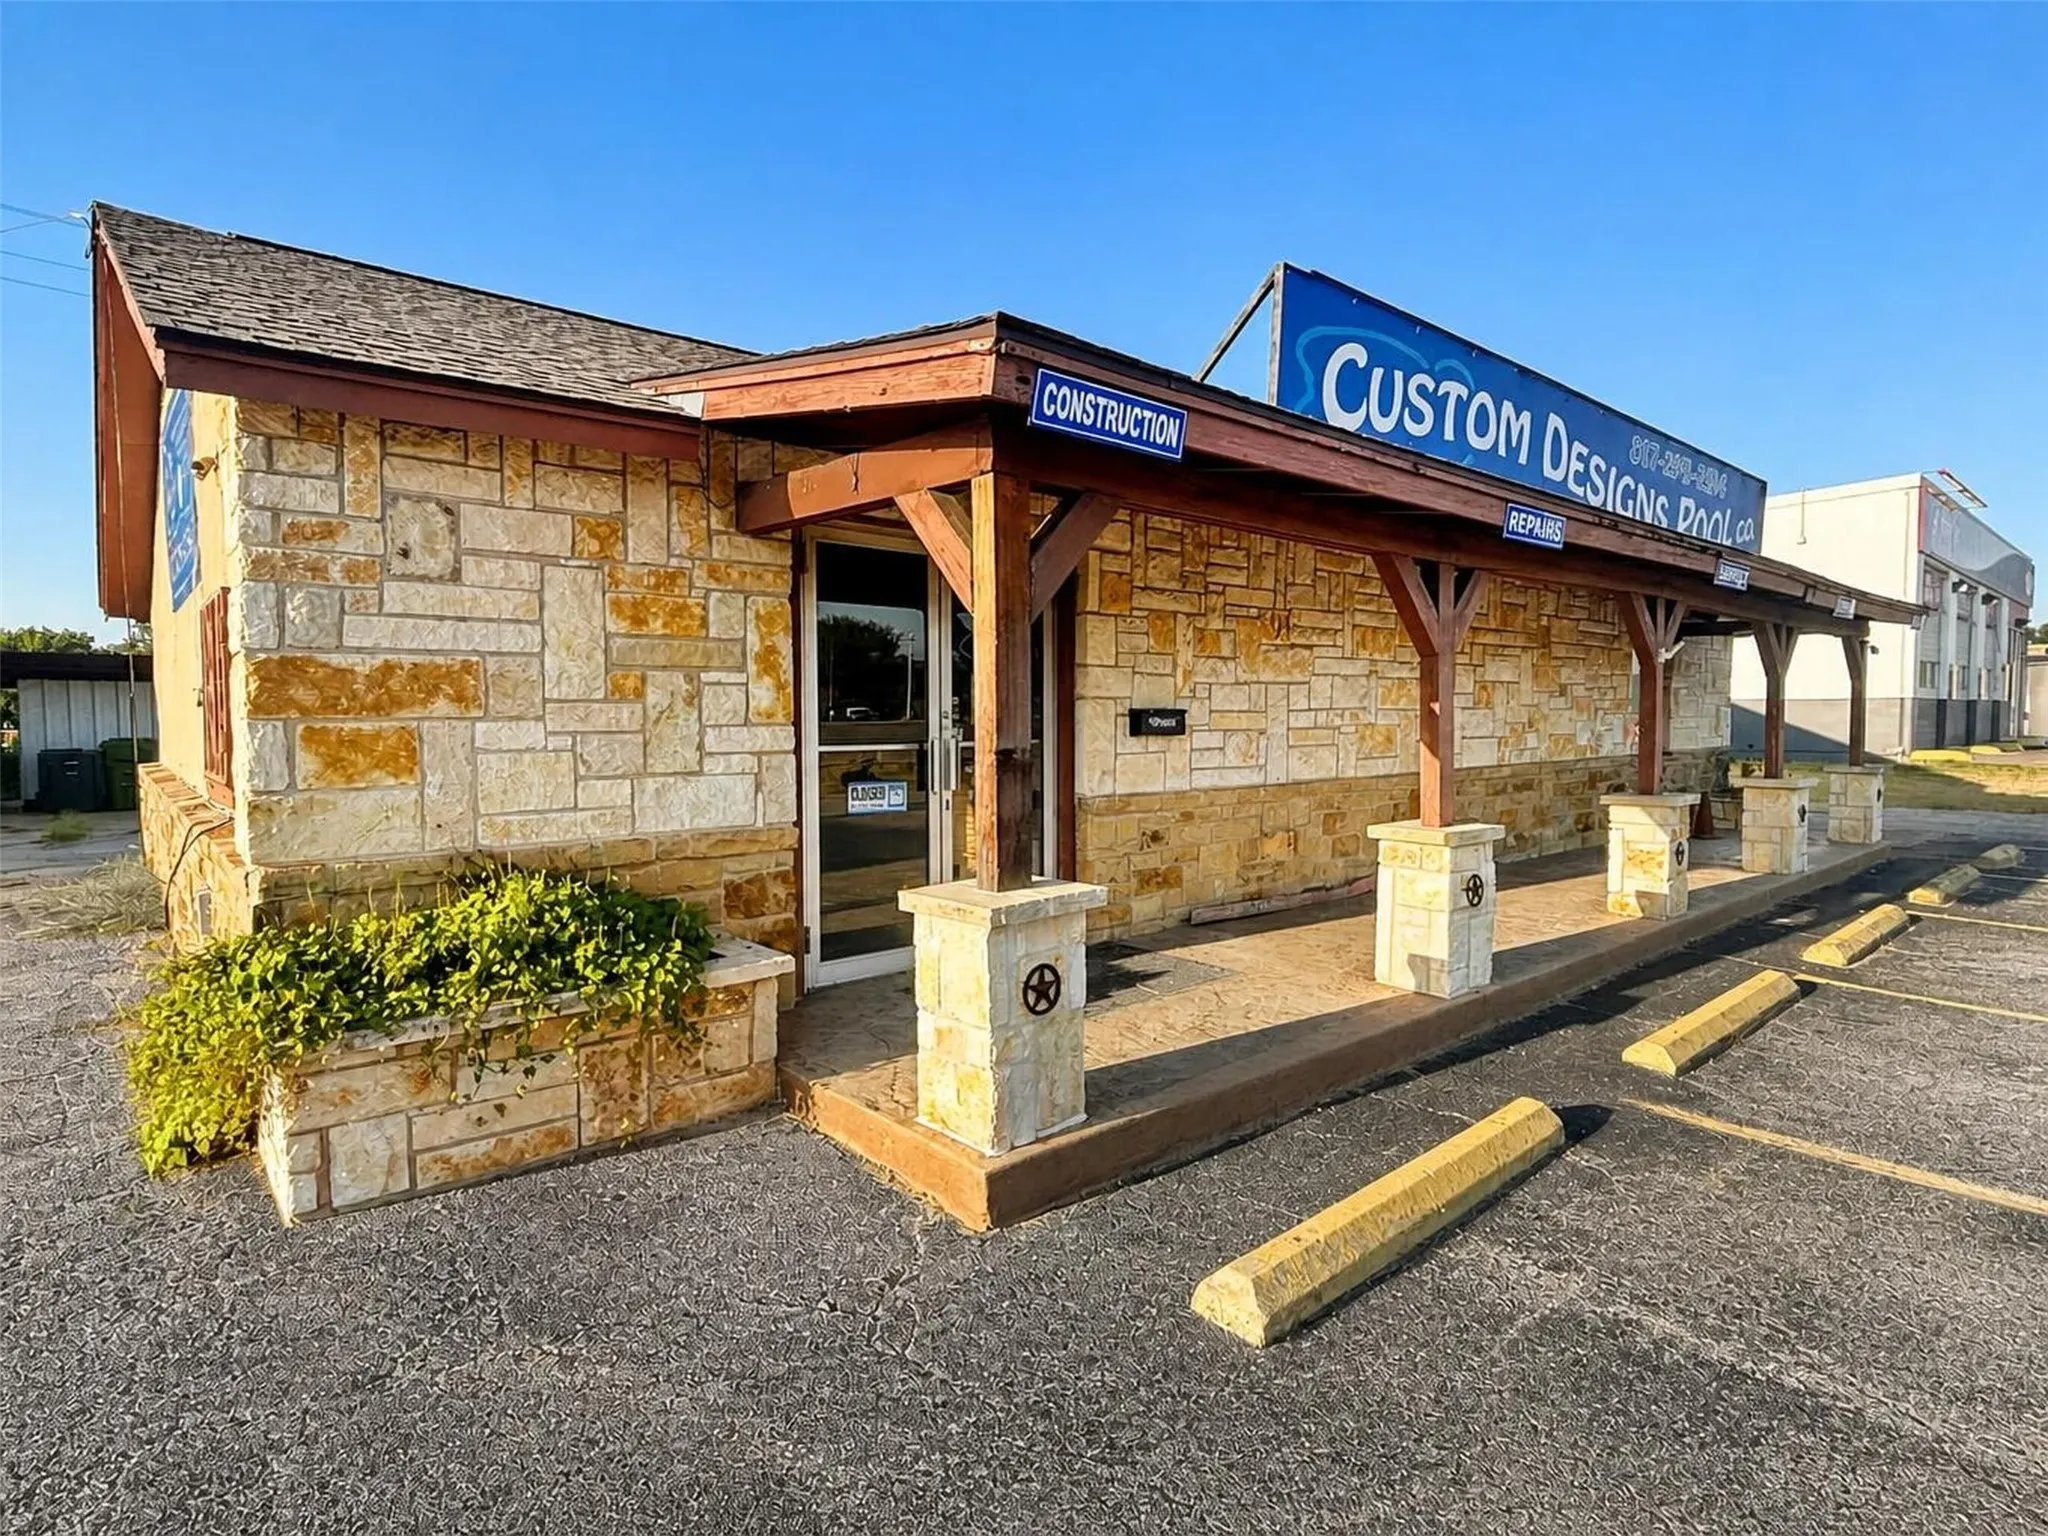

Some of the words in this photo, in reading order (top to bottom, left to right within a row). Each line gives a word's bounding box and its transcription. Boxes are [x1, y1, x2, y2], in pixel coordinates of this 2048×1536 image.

[1043, 382, 1180, 449] CONSTRUCTION
[1322, 342, 1532, 466] CUSTOM
[1542, 412, 1669, 529] DESIGNS
[1677, 495, 1733, 546] POOL
[1509, 510, 1563, 542] REPAIRS
